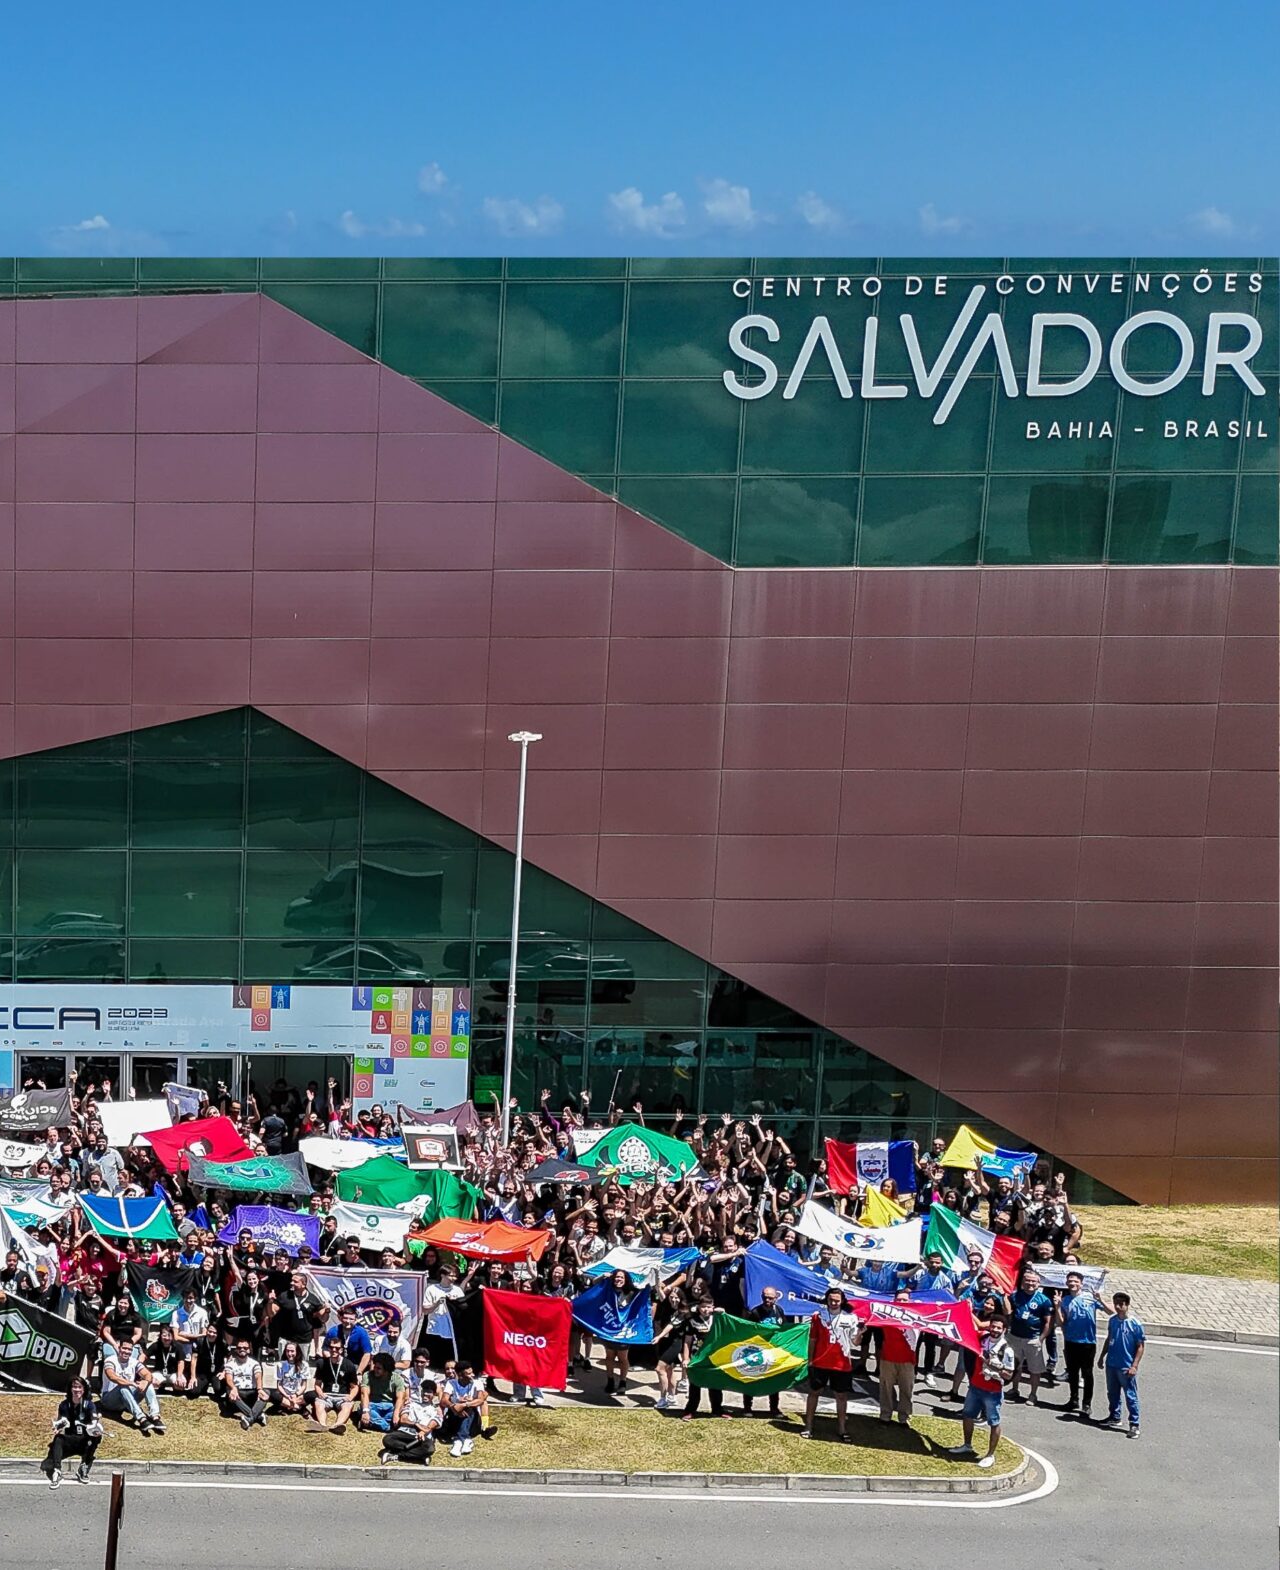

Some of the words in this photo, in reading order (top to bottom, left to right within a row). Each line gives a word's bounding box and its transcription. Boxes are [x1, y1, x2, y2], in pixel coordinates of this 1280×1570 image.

[732, 276, 882, 297] CENTRO
[905, 275, 948, 295] DE
[995, 268, 1263, 298] CONVENÇÕES
[722, 284, 1267, 424] SALVADOR
[1026, 420, 1114, 439] BAHIA
[1164, 420, 1268, 438] BRASIL
[107, 1007, 168, 1019] 2023
[333, 1283, 395, 1307] OLÉGIO
[358, 1310, 386, 1327] EUS
[503, 1331, 547, 1349] NEGO
[30, 1338, 77, 1368] BDP
